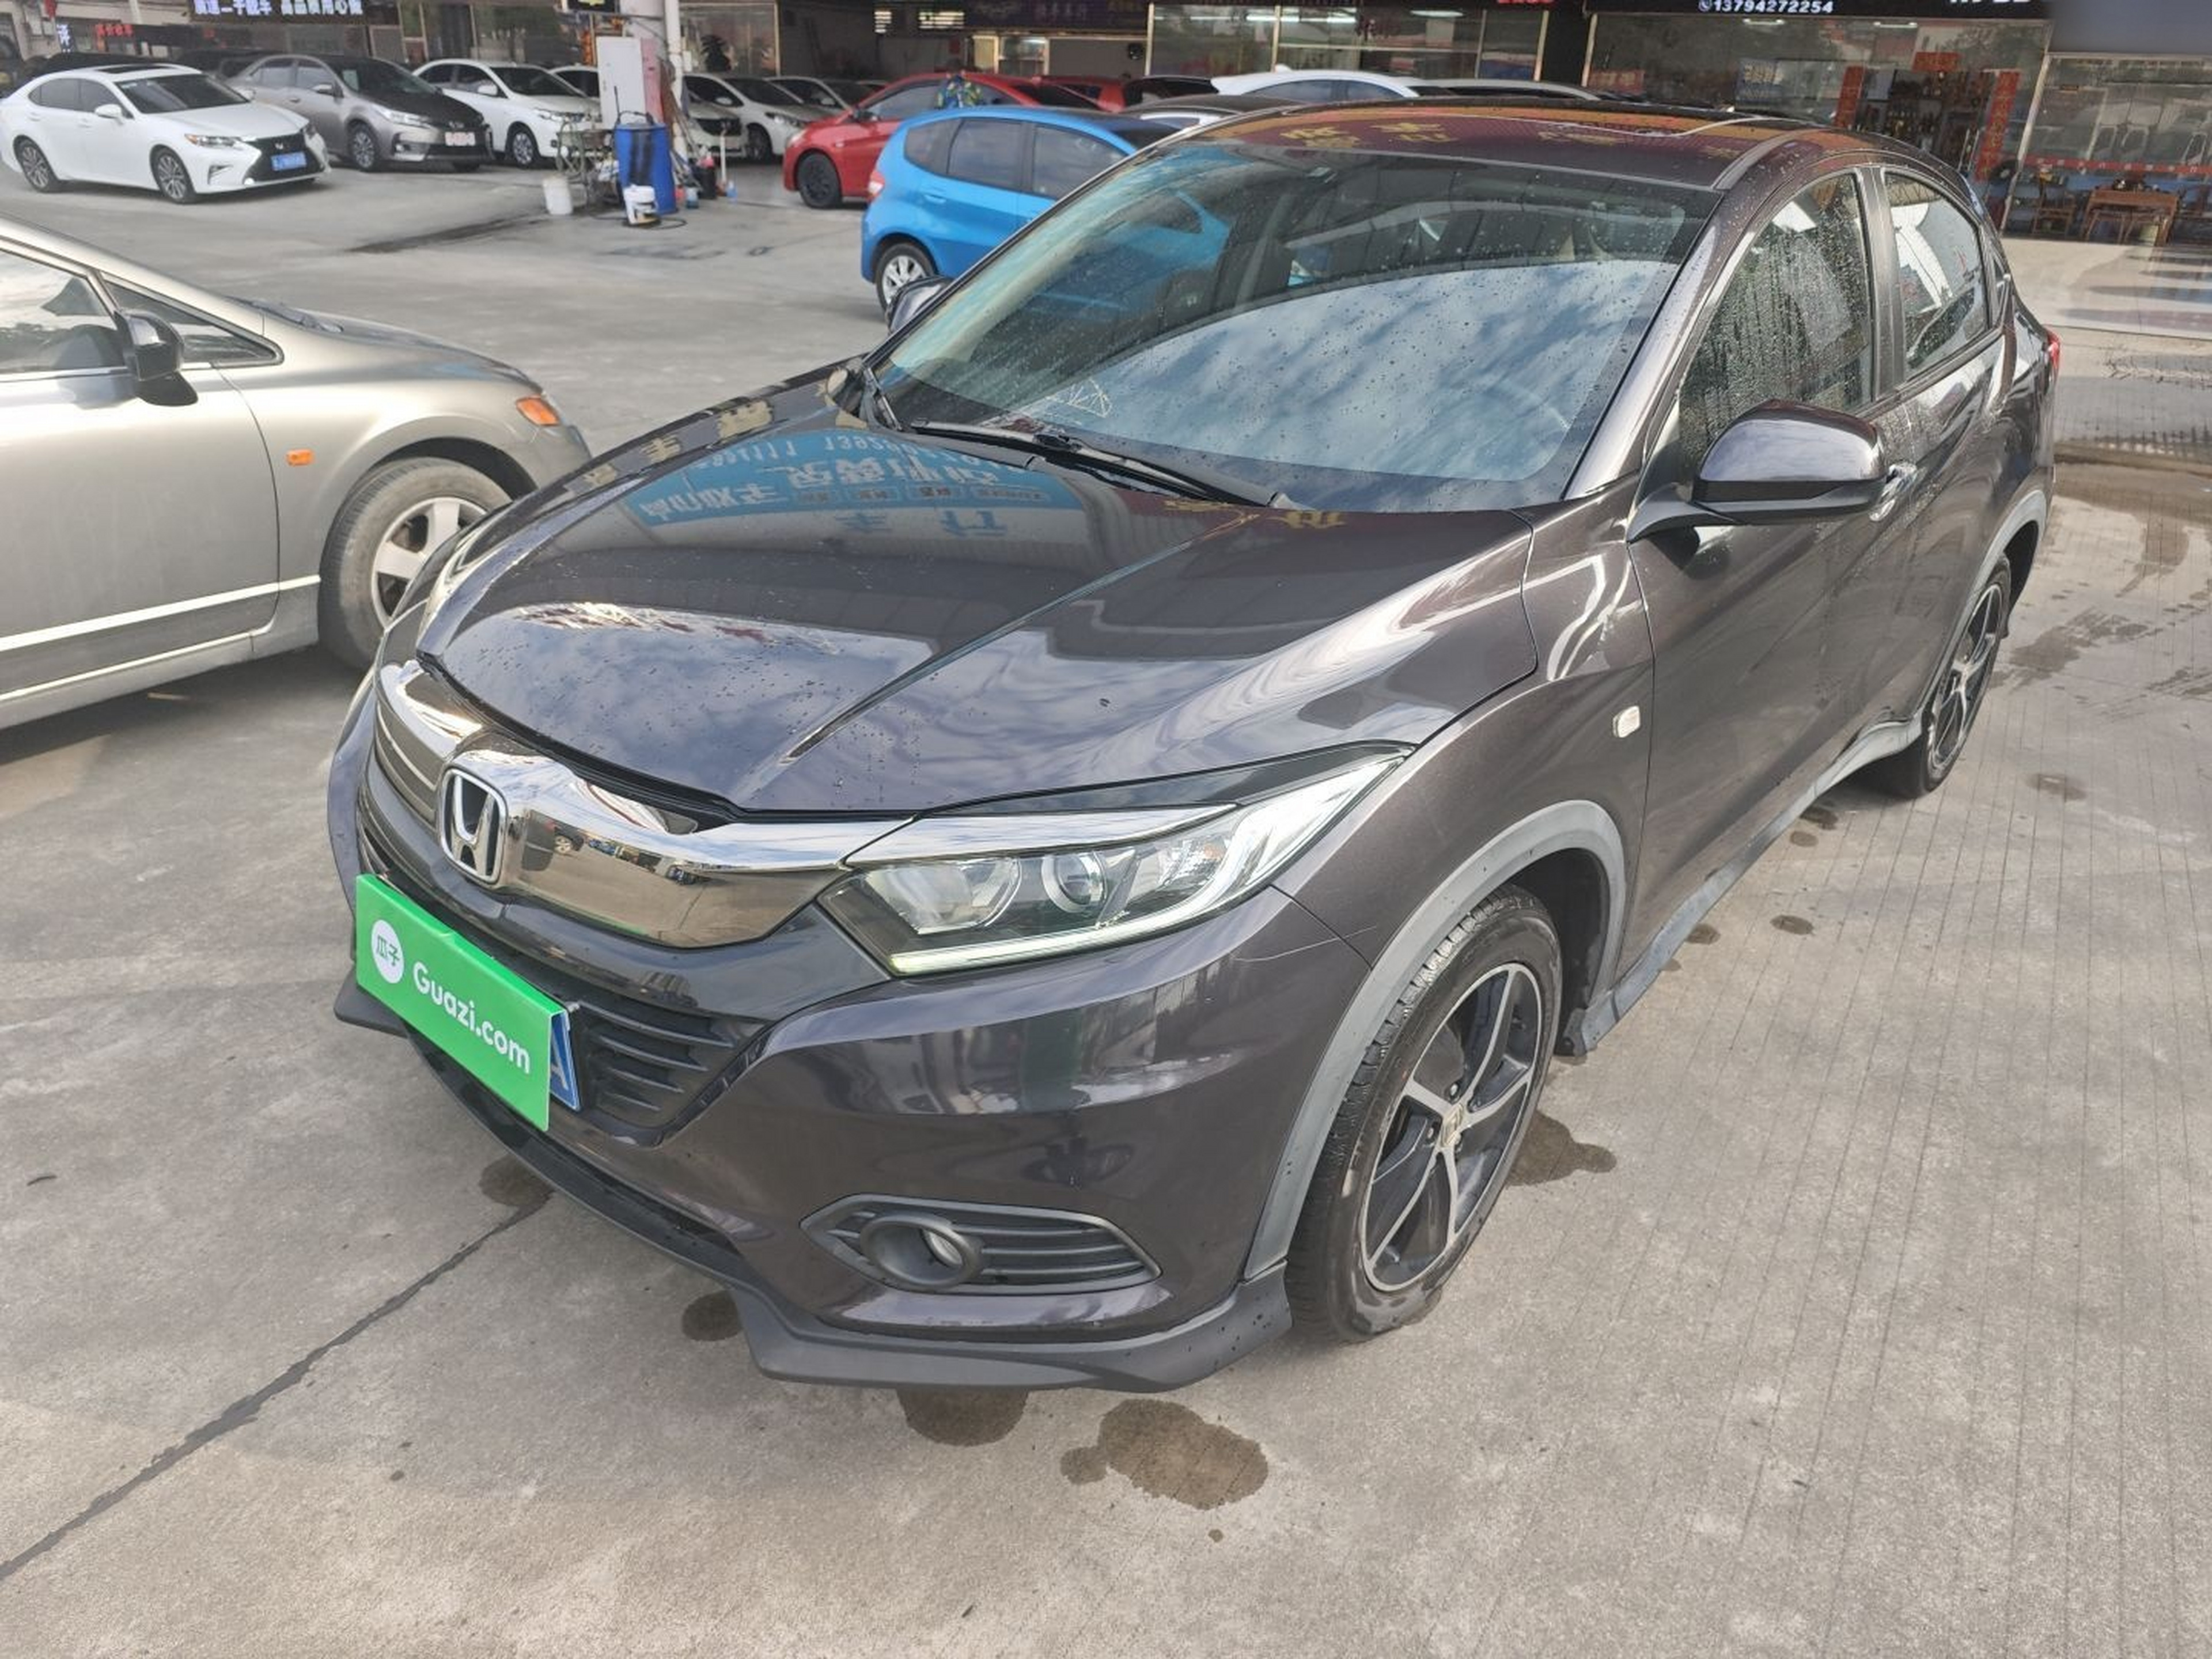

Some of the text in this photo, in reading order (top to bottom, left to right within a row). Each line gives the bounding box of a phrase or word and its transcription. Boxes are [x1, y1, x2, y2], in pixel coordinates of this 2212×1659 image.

[1714, 1, 1833, 13] 13794272254
[376, 934, 400, 967] 瓜子
[412, 961, 531, 1075] Guazi.com
